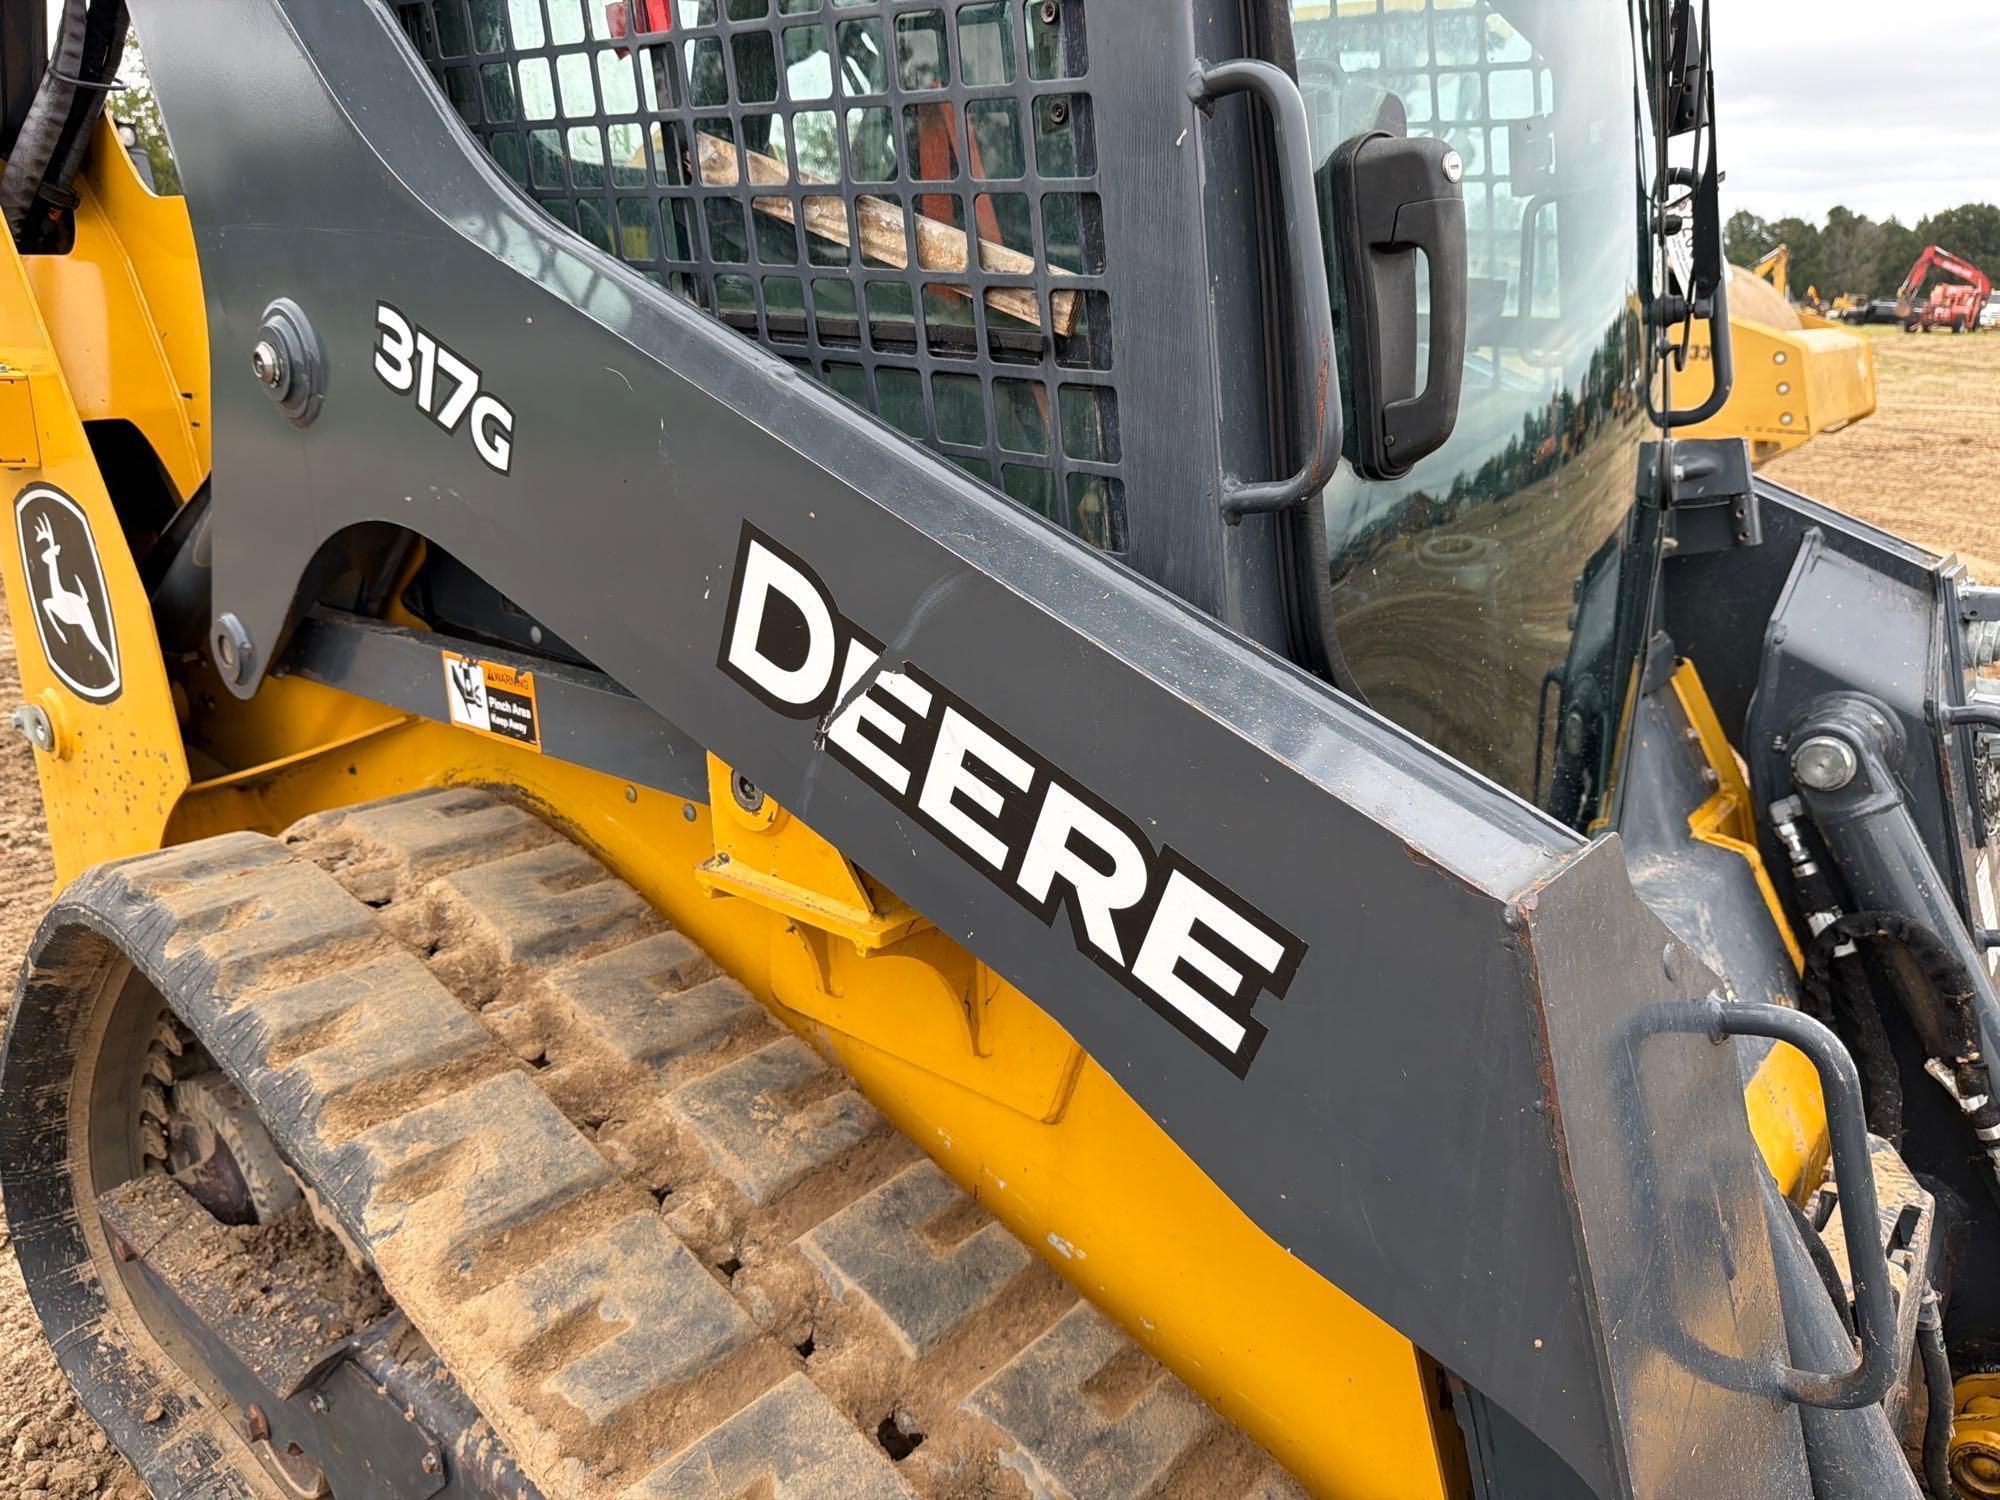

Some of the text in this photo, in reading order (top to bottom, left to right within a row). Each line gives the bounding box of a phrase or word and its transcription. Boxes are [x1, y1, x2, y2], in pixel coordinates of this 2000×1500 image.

[374, 305, 513, 471] 317G
[488, 696, 532, 719] Pinch Area
[490, 713, 528, 735] Keep Away
[728, 539, 1286, 1054] DEERE
